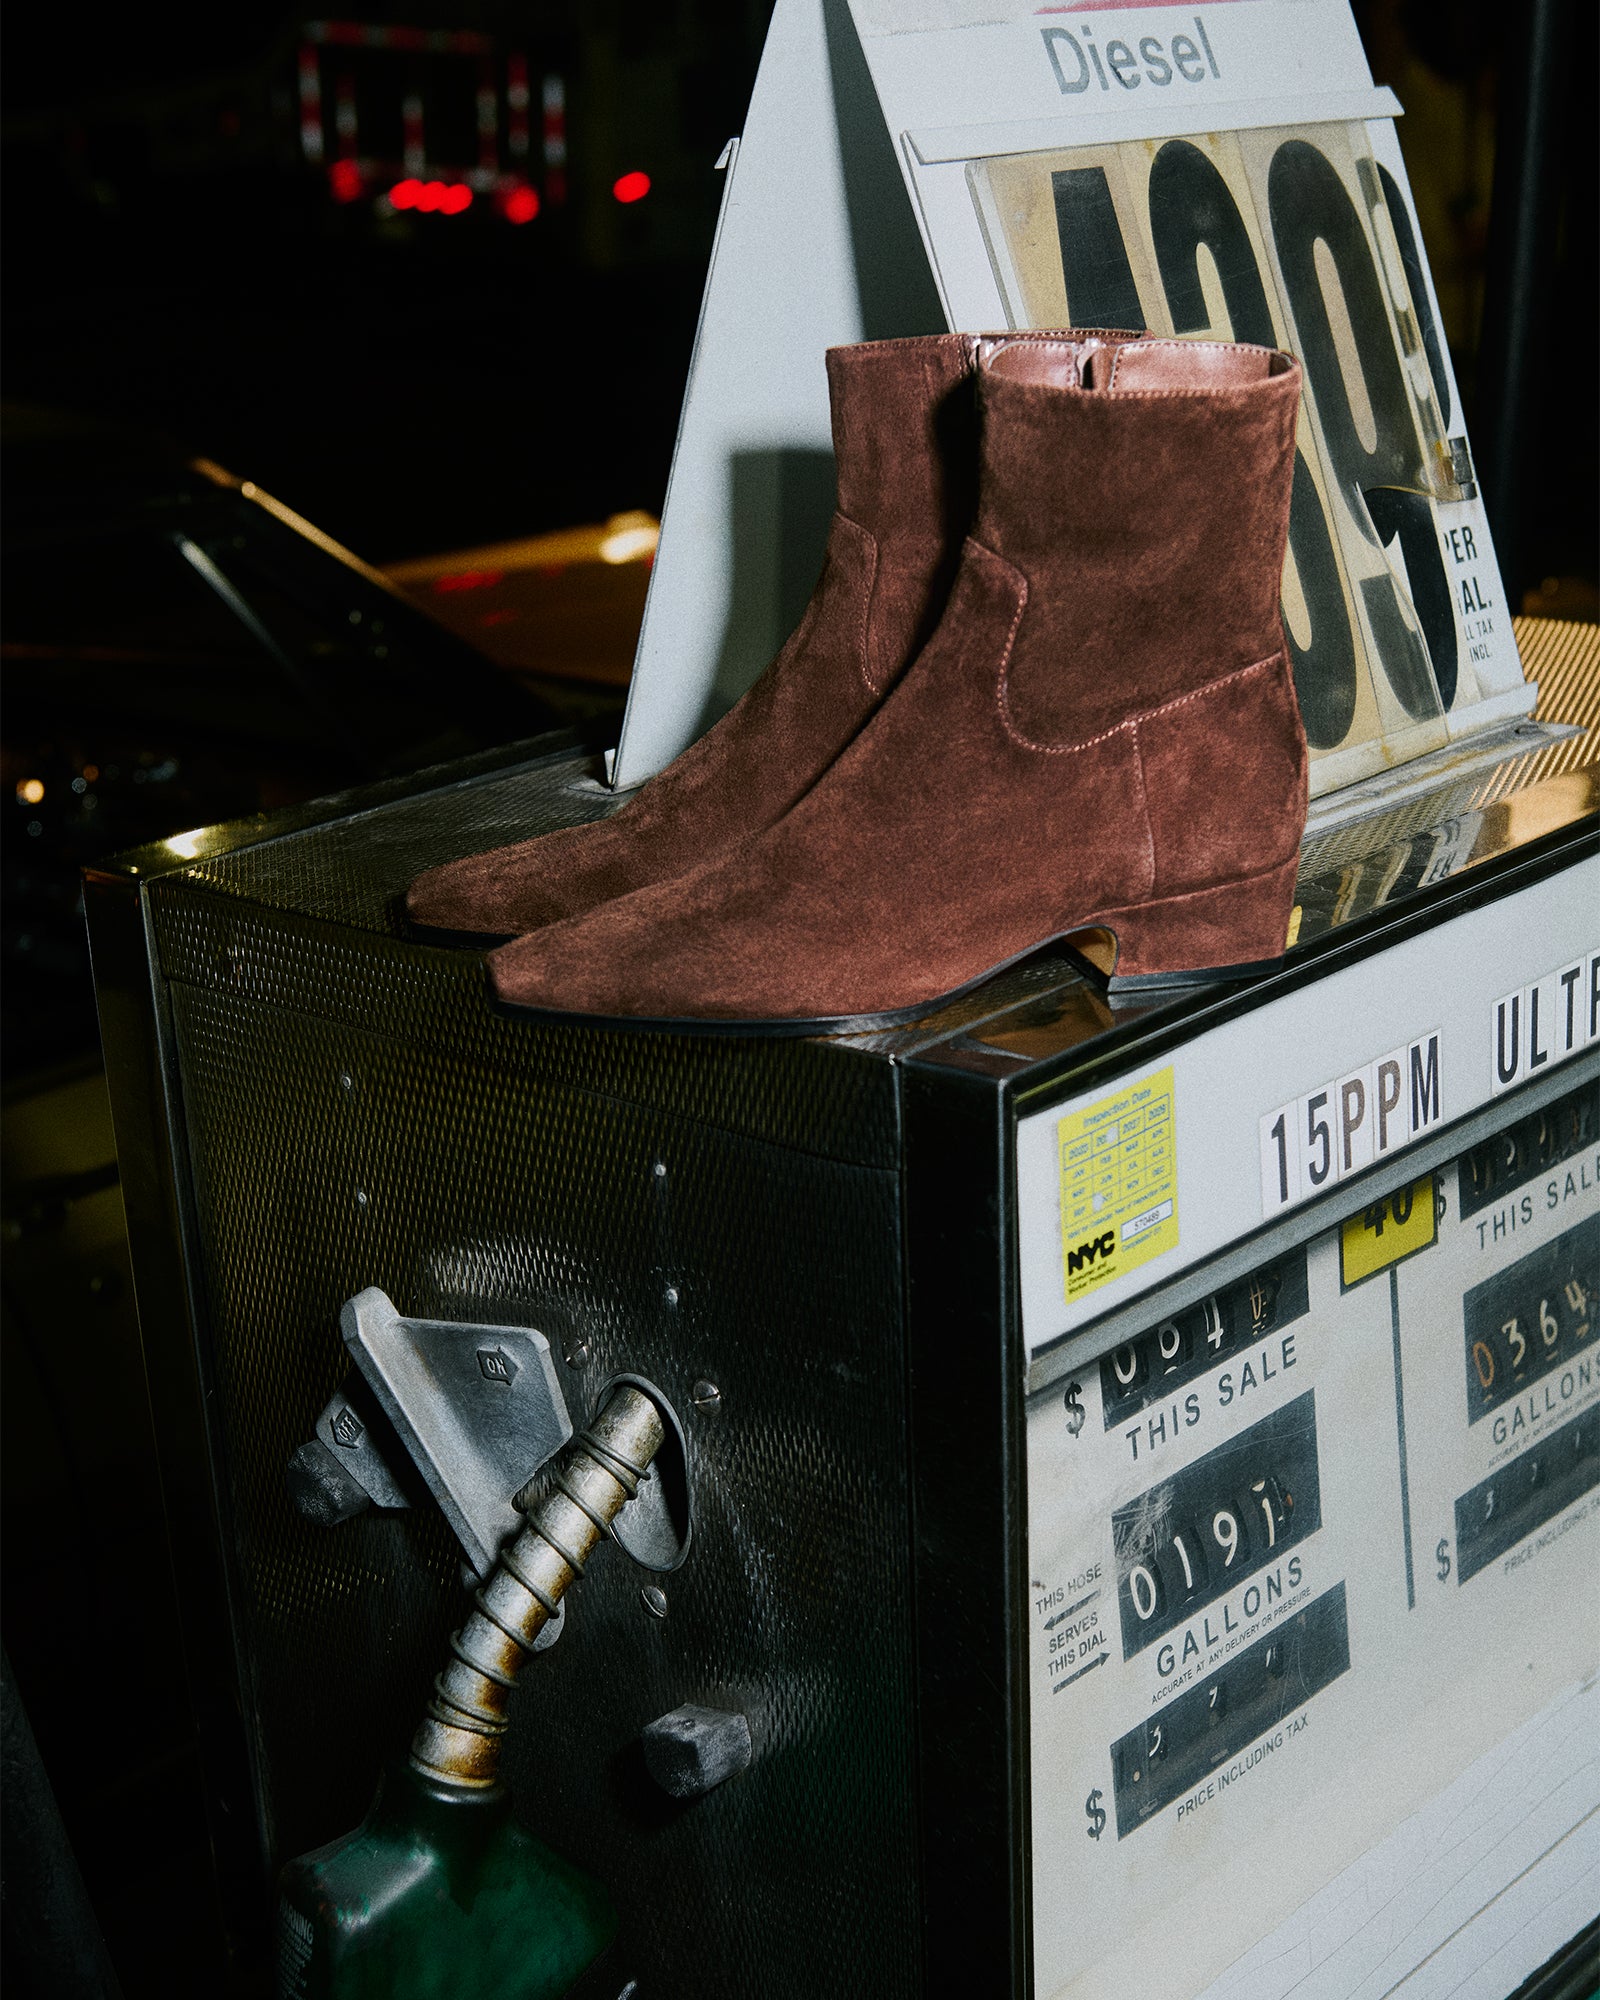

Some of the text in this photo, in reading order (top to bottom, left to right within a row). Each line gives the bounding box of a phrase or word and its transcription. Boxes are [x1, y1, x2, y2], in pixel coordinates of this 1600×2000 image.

[1039, 17, 1221, 94] Diesel
[1444, 526, 1477, 564] ER
[1454, 576, 1492, 616] AL.
[1132, 1088, 1151, 1105] Date
[1270, 1035, 1440, 1204] 15PPM
[1476, 1196, 1533, 1250] THIS
[1067, 1230, 1115, 1276] NYC
[485, 1355, 507, 1376] ON
[1063, 1381, 1086, 1439] $
[1125, 1335, 1298, 1461] THIS SALE
[336, 1414, 357, 1442] OFF
[1435, 1538, 1451, 1584] $
[1035, 1562, 1102, 1615] THIS HOSE
[1049, 1611, 1099, 1655] SERVES
[1156, 1555, 1303, 1678] GALLONS
[1047, 1630, 1108, 1677] THIS DIAL
[1151, 1586, 1312, 1705] ACCURATE AT ANY DELIVERY OR PRESSURE
[1176, 1713, 1309, 1822] PRICE INCLUDING TAX
[1085, 1787, 1107, 1842] $
